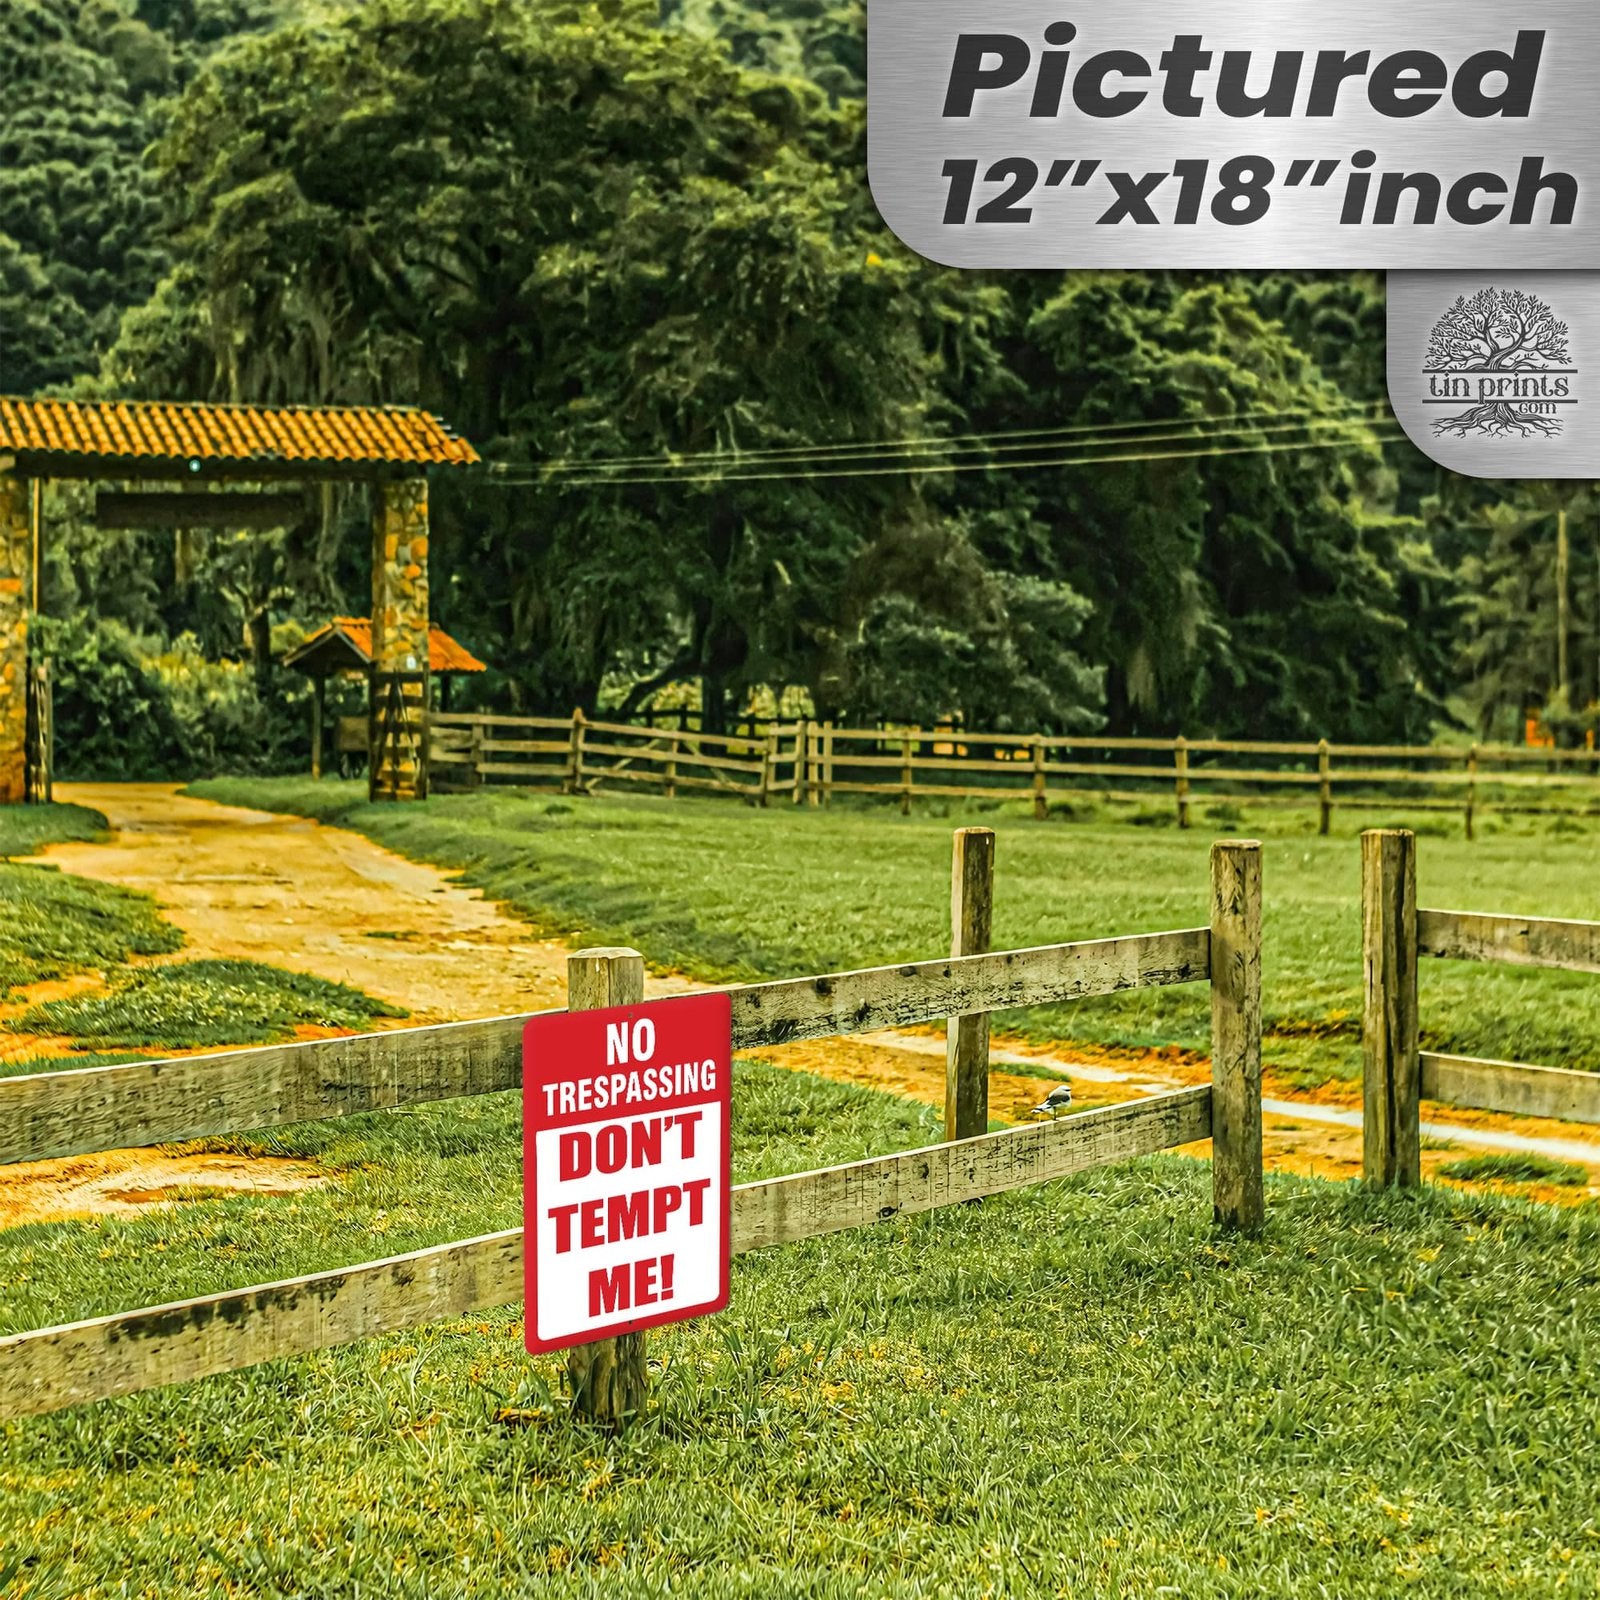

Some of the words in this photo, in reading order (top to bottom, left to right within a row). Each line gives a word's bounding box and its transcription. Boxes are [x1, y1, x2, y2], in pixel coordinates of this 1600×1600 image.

[606, 1018, 656, 1066] NO
[542, 1059, 717, 1116] TRESPASSING
[559, 1111, 703, 1182] DON'T
[548, 1178, 711, 1254] TEMPT
[588, 1254, 675, 1318] ME!
